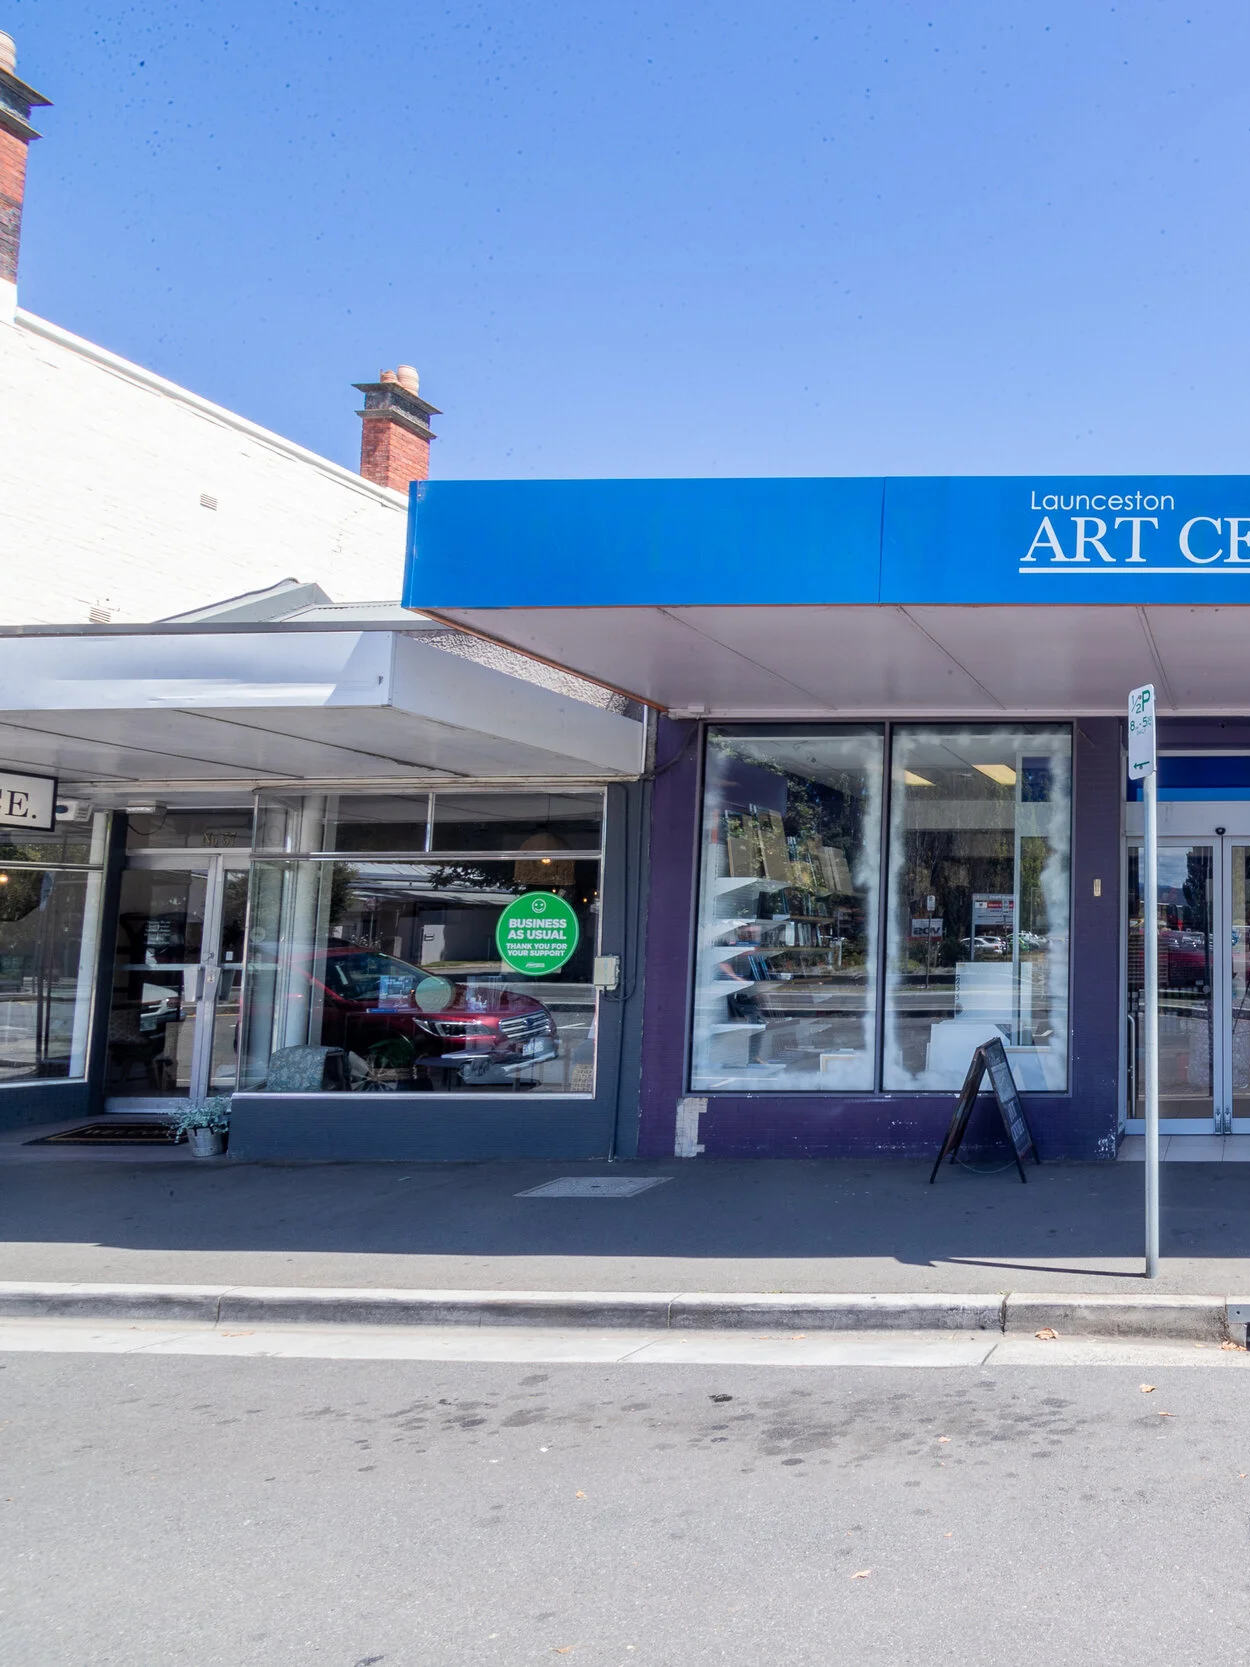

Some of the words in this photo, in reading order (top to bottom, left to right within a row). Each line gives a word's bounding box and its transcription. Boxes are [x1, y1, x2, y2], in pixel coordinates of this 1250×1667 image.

[1030, 490, 1175, 511] Launceston
[1019, 516, 1159, 563] ART
[508, 918, 567, 928] BUSINESS
[507, 930, 524, 940] AS
[526, 930, 567, 940] USUAL
